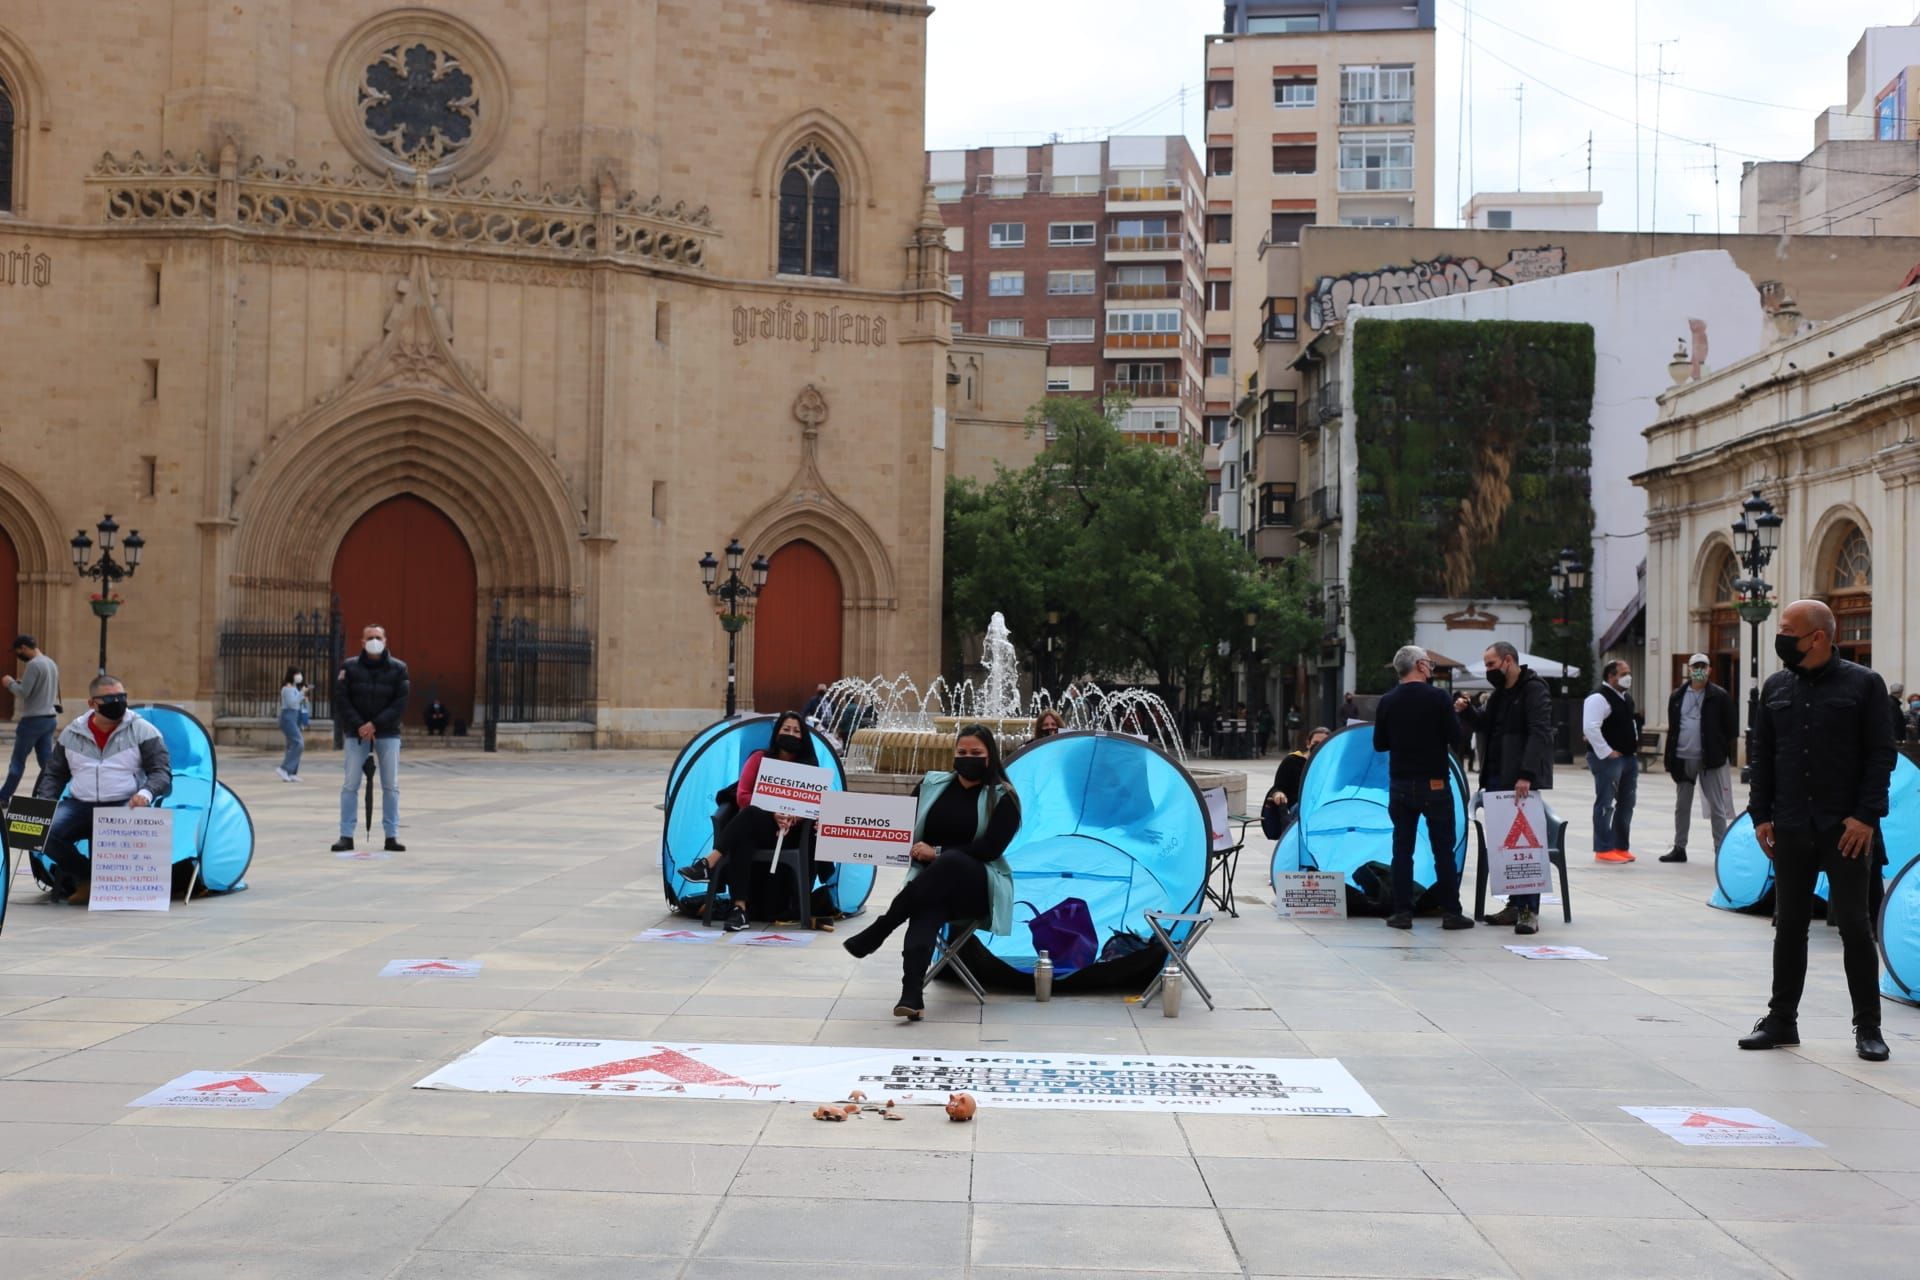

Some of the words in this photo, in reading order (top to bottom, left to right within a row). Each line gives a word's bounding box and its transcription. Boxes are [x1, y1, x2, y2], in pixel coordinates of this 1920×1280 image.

[758, 785, 792, 797] AYUDAS
[792, 791, 820, 802] DIGNA
[844, 816, 890, 827] ESTAMOS
[823, 826, 909, 840] CRIMINALIZADOS
[1122, 1061, 1256, 1069] PLANTA
[579, 1083, 687, 1094] 13-A
[1077, 1082, 1191, 1090] AYUDAS
